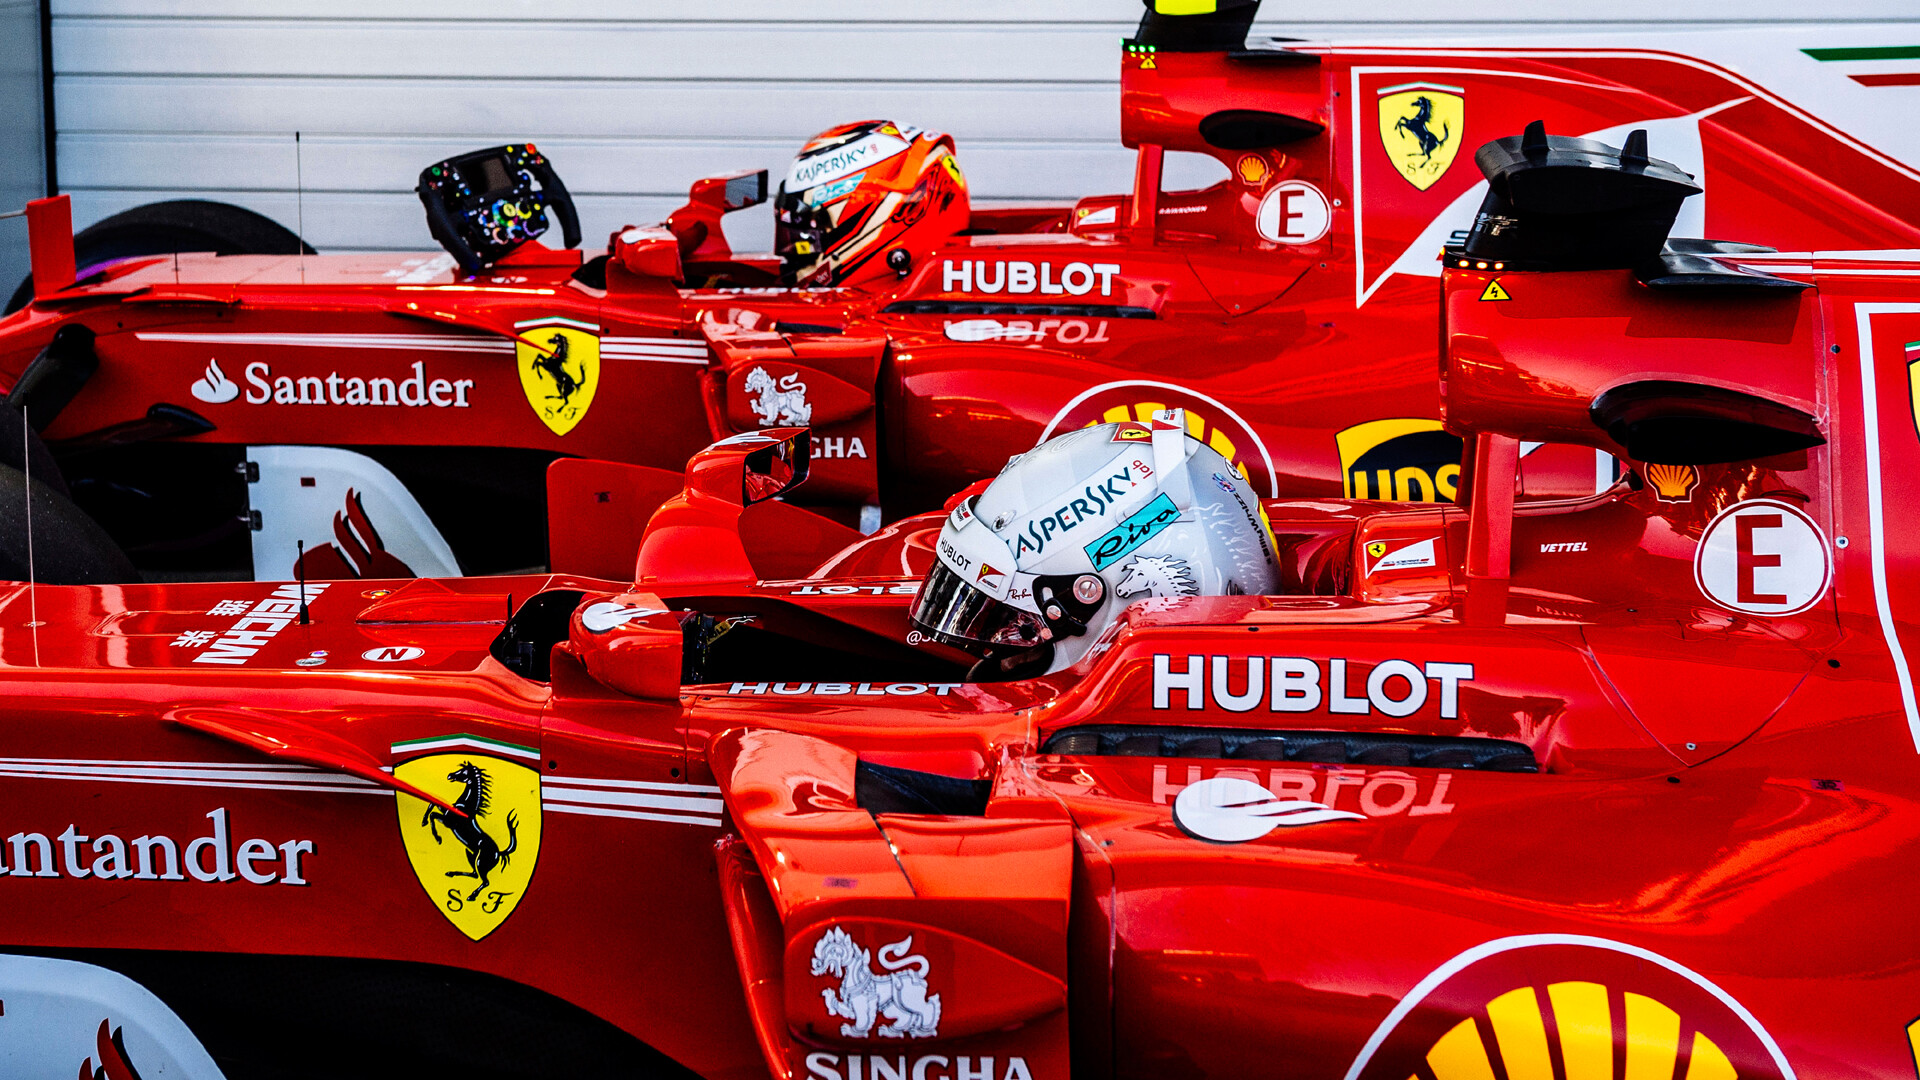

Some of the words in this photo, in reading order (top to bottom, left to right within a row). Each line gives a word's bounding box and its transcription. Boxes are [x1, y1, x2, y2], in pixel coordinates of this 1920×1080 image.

[1278, 190, 1305, 238] E
[942, 260, 1121, 297] HUBLOT
[245, 361, 474, 408] Santander
[1006, 466, 1131, 560] ASPERSKY
[939, 538, 972, 571] HUBLOT
[1093, 509, 1176, 566] Riva
[1540, 541, 1588, 553] VETTEL
[1736, 513, 1788, 605] E
[728, 682, 964, 696] HUBLOT
[1152, 654, 1474, 719] HUBLOT
[0, 808, 314, 886] ntander
